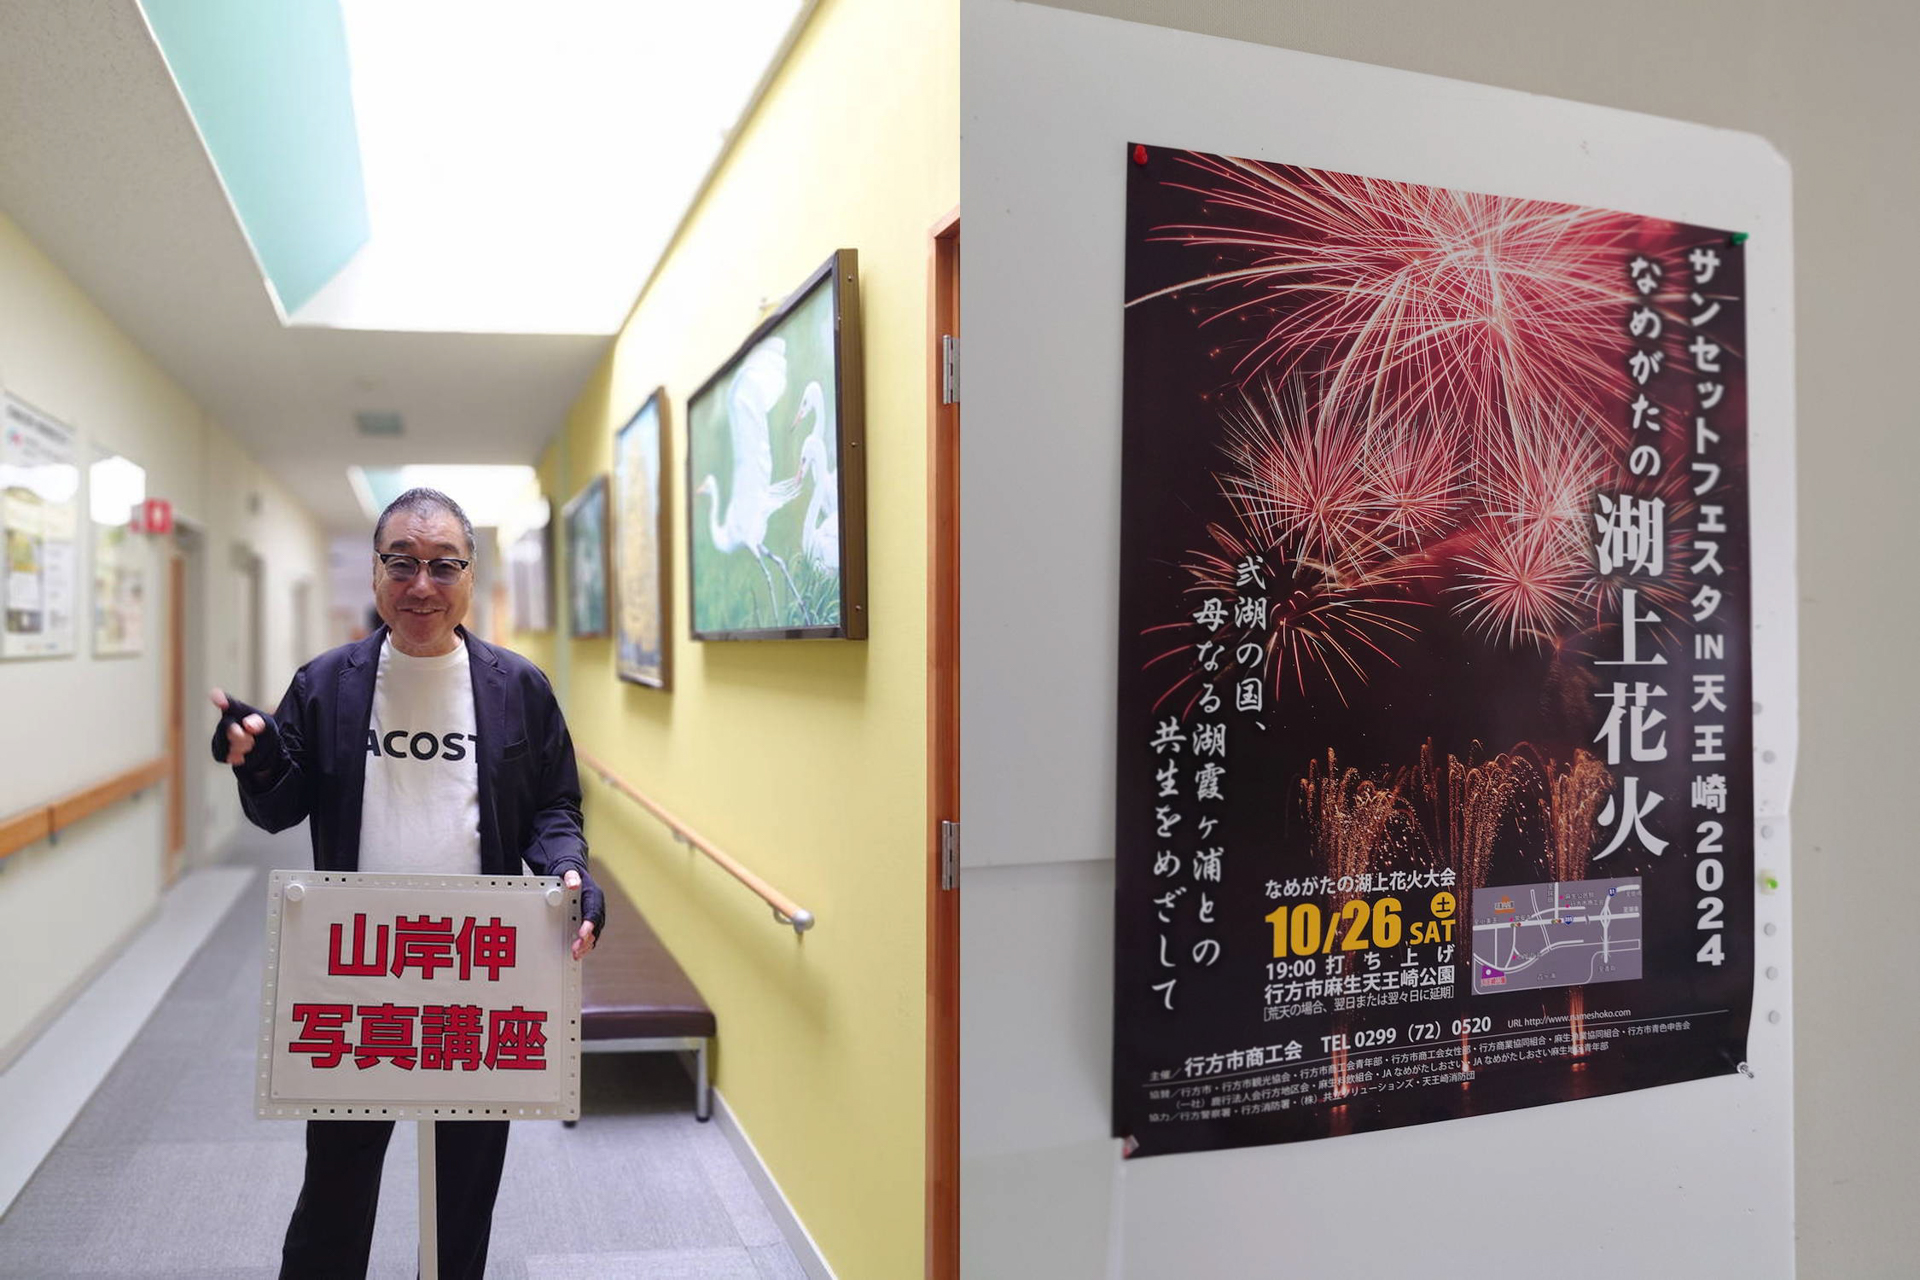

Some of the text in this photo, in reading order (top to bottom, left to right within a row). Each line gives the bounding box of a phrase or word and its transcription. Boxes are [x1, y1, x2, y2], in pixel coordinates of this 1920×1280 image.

[1150, 716, 1187, 1010] 共生をめざして
[1264, 867, 1456, 899] なめがたの湖上花火大会
[1265, 897, 1402, 958] 10/26
[1409, 919, 1456, 945] SAT
[328, 913, 517, 981] 山岸伸
[1264, 965, 1455, 1005] 行方市麻生天王崎公園
[1265, 959, 1316, 980] 19:00
[289, 1003, 548, 1070] 写真講座
[1508, 1019, 1523, 1028] URL
[1321, 1034, 1351, 1053] TEL
